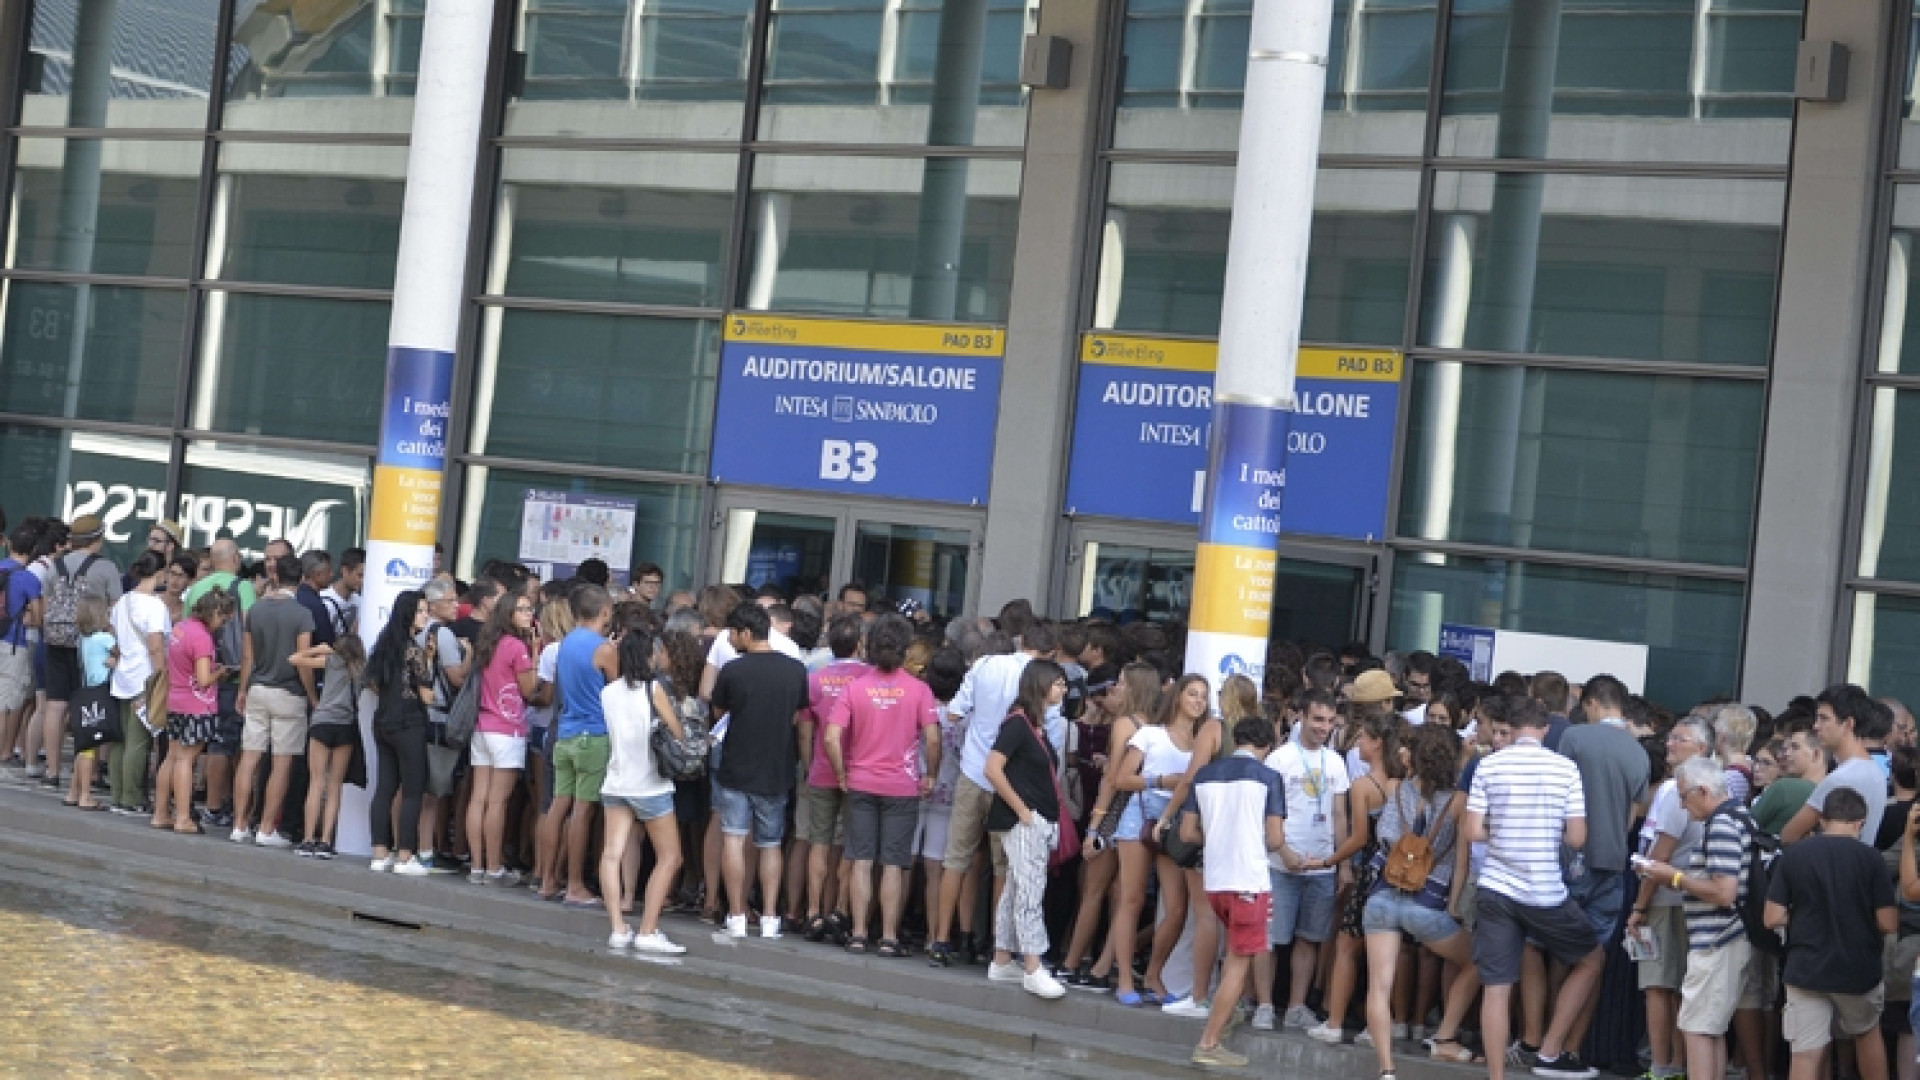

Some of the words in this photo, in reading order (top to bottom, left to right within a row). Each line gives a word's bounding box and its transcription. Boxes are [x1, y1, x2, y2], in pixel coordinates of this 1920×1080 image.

[941, 333, 970, 348] PAD
[973, 334, 993, 349] B3
[742, 356, 976, 390] AUDITORIUM/SALONE
[1337, 356, 1367, 372] PAD
[1372, 358, 1393, 374] B3
[775, 396, 828, 417] INTESA
[1140, 422, 1200, 446] INTESA
[819, 439, 878, 482] B3
[1253, 468, 1285, 486] med
